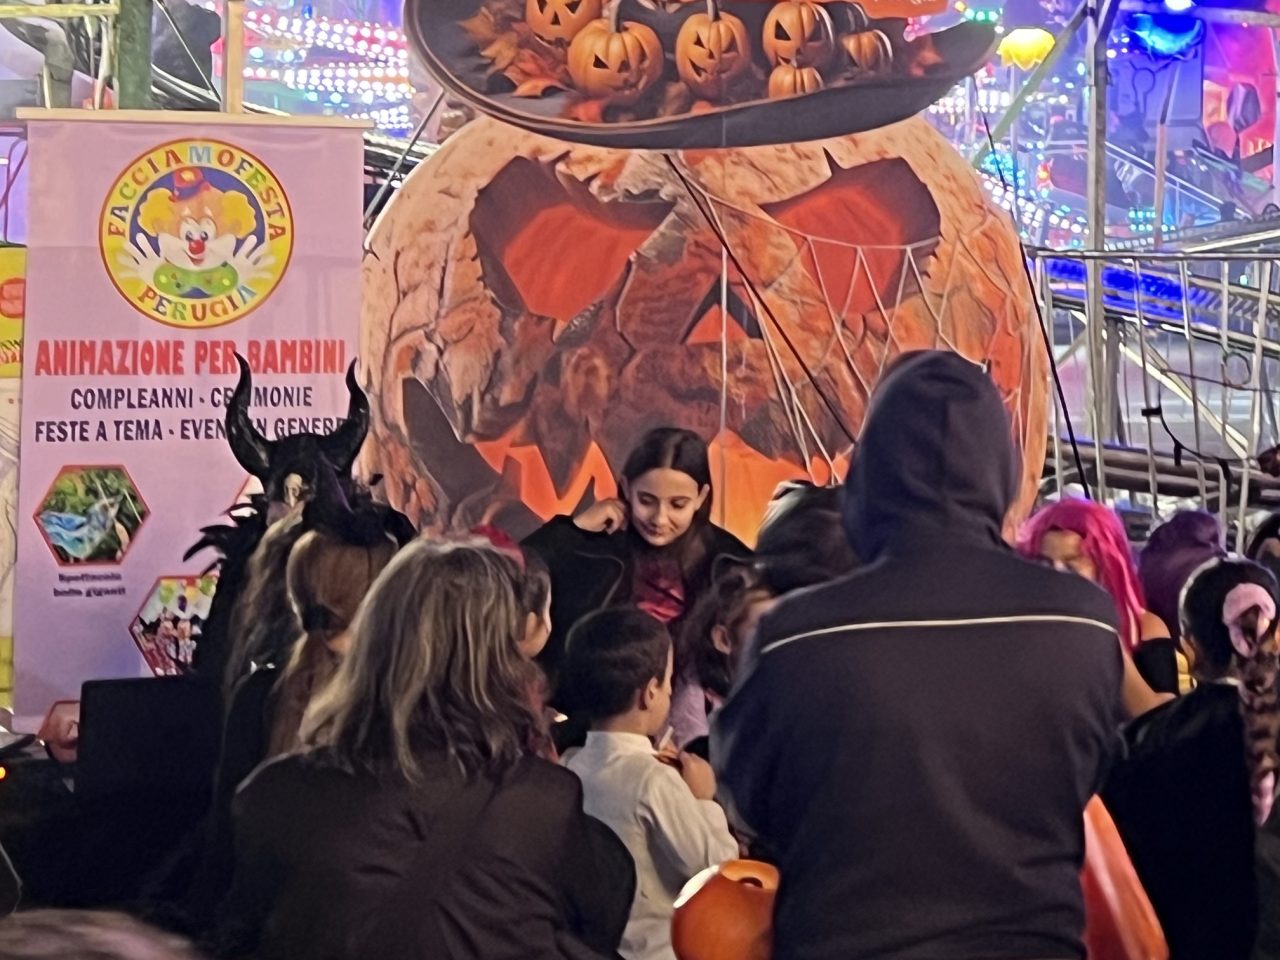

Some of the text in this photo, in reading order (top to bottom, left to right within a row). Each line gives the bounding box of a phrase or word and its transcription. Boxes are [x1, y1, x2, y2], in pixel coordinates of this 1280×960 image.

[136, 285, 257, 322] PERUGIA
[34, 339, 185, 376] ANIMAZIONE
[194, 339, 238, 375] PER
[247, 339, 346, 374] BAMBINI
[70, 387, 194, 410] COMPLEANNI
[210, 386, 313, 408] CEMONIE
[34, 420, 90, 442] FESTE
[95, 419, 108, 442] A
[113, 418, 164, 441] TEMA
[180, 417, 227, 440] EVEN
